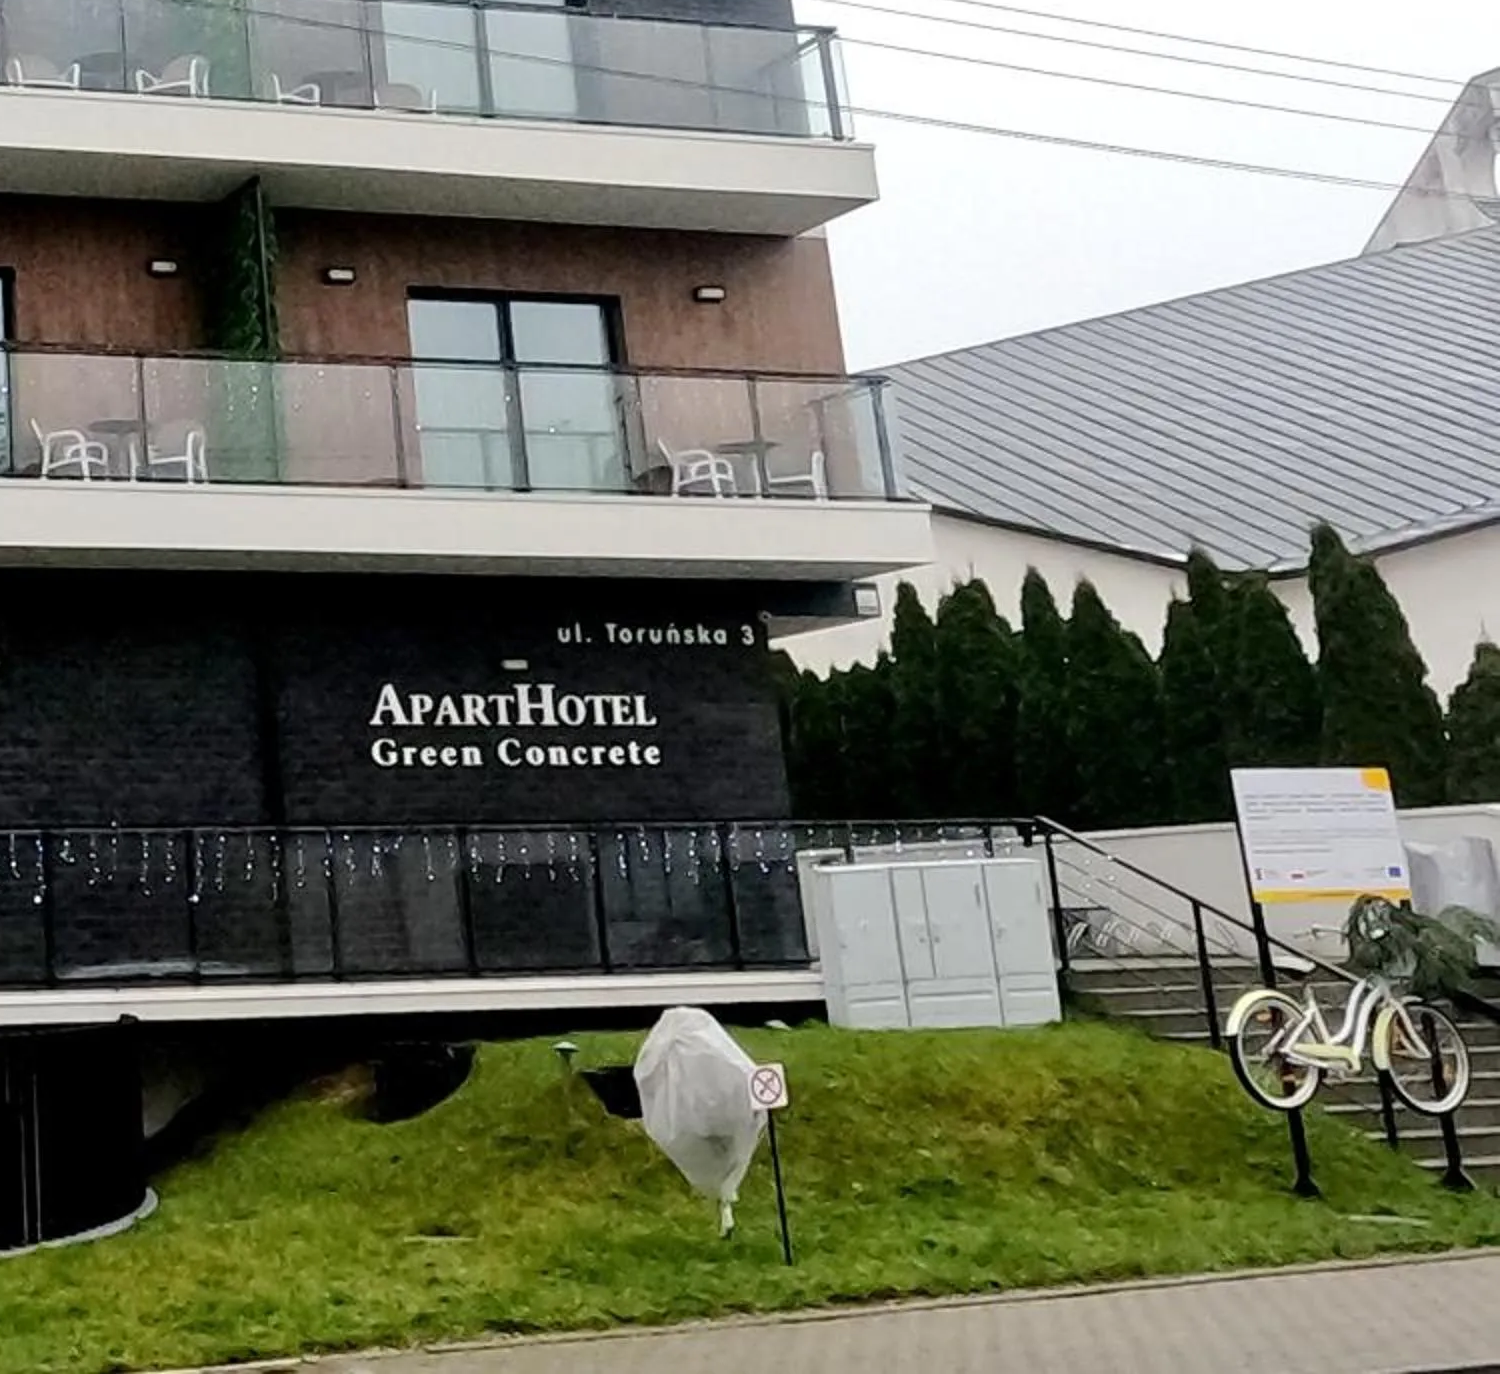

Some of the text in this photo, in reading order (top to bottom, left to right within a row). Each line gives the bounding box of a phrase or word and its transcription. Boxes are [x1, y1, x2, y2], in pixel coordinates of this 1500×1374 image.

[557, 622, 756, 647] ul. Toruńska 3
[371, 737, 662, 767] Green Concrete
